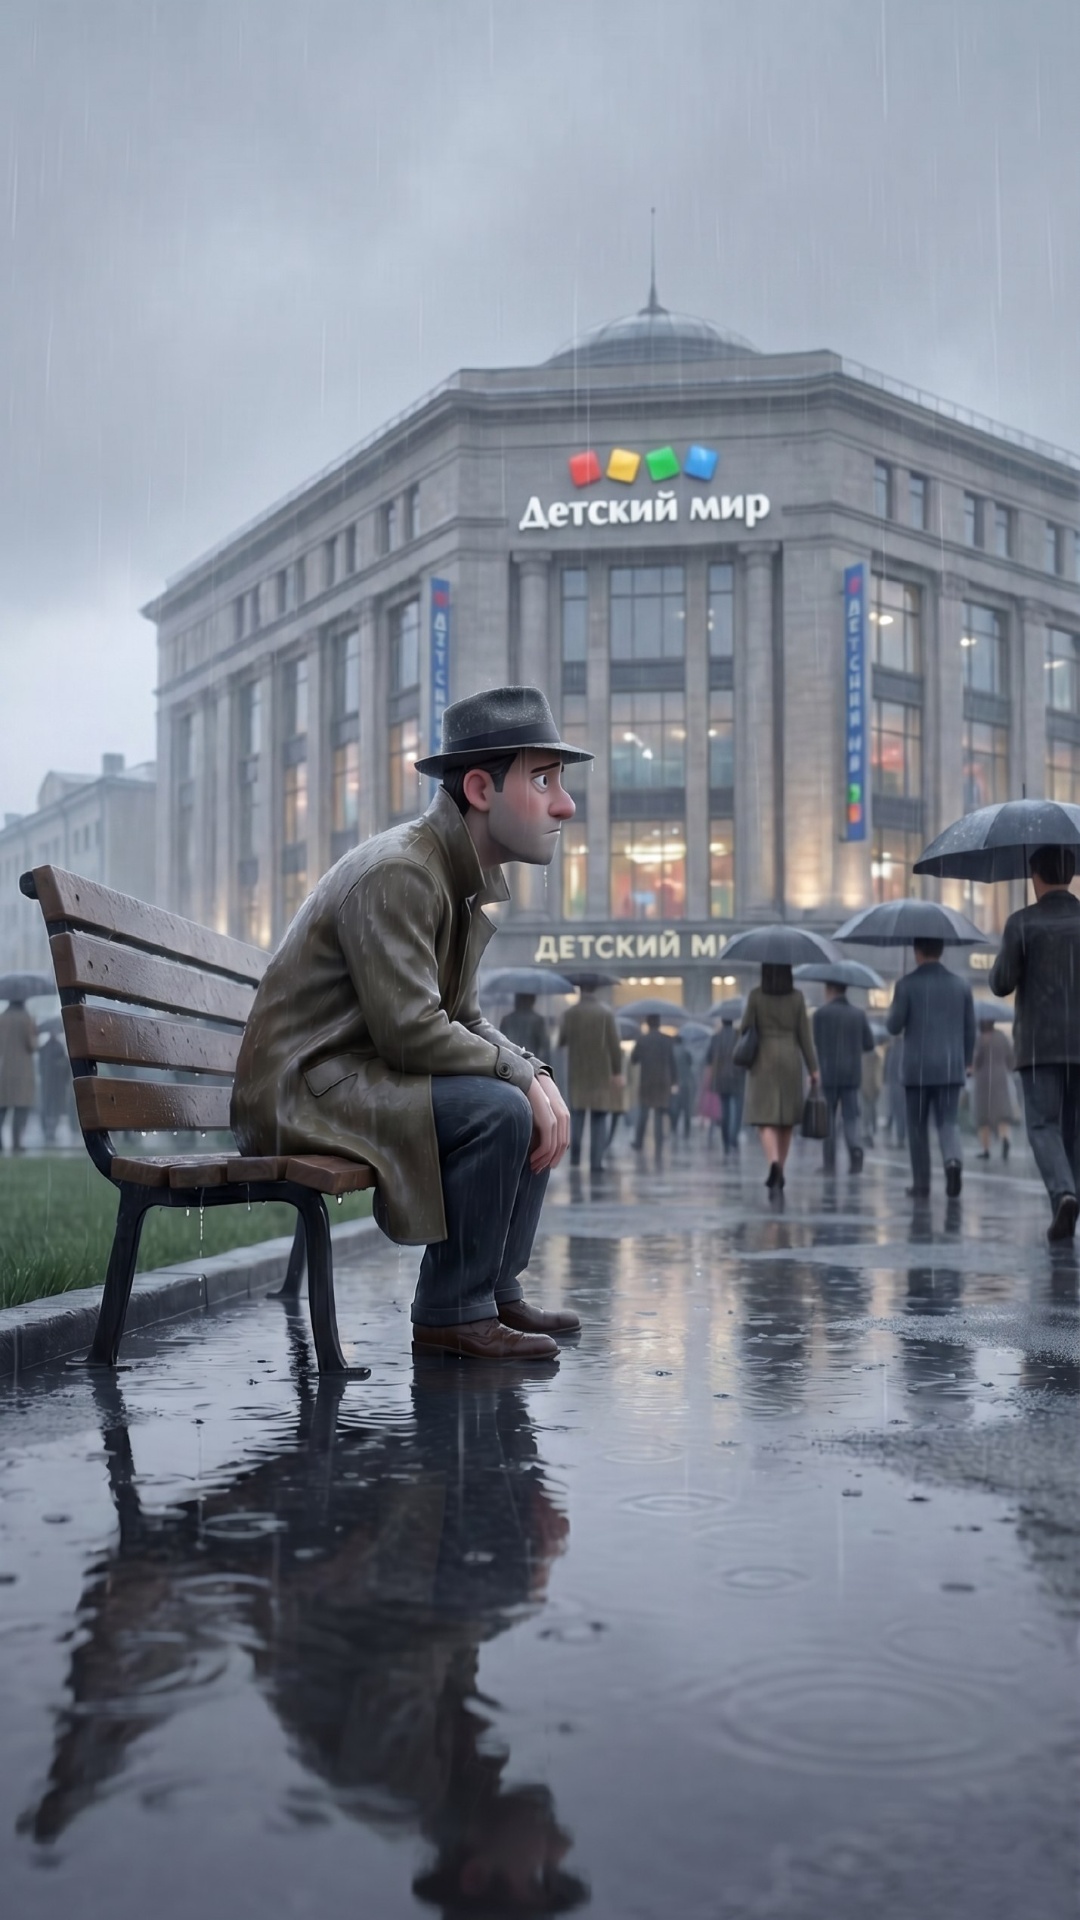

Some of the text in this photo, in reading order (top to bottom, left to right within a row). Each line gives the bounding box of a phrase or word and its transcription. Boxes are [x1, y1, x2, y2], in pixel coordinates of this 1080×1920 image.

[519, 490, 770, 530] Детский мир
[534, 930, 680, 963] ДЕТСКИЙ
